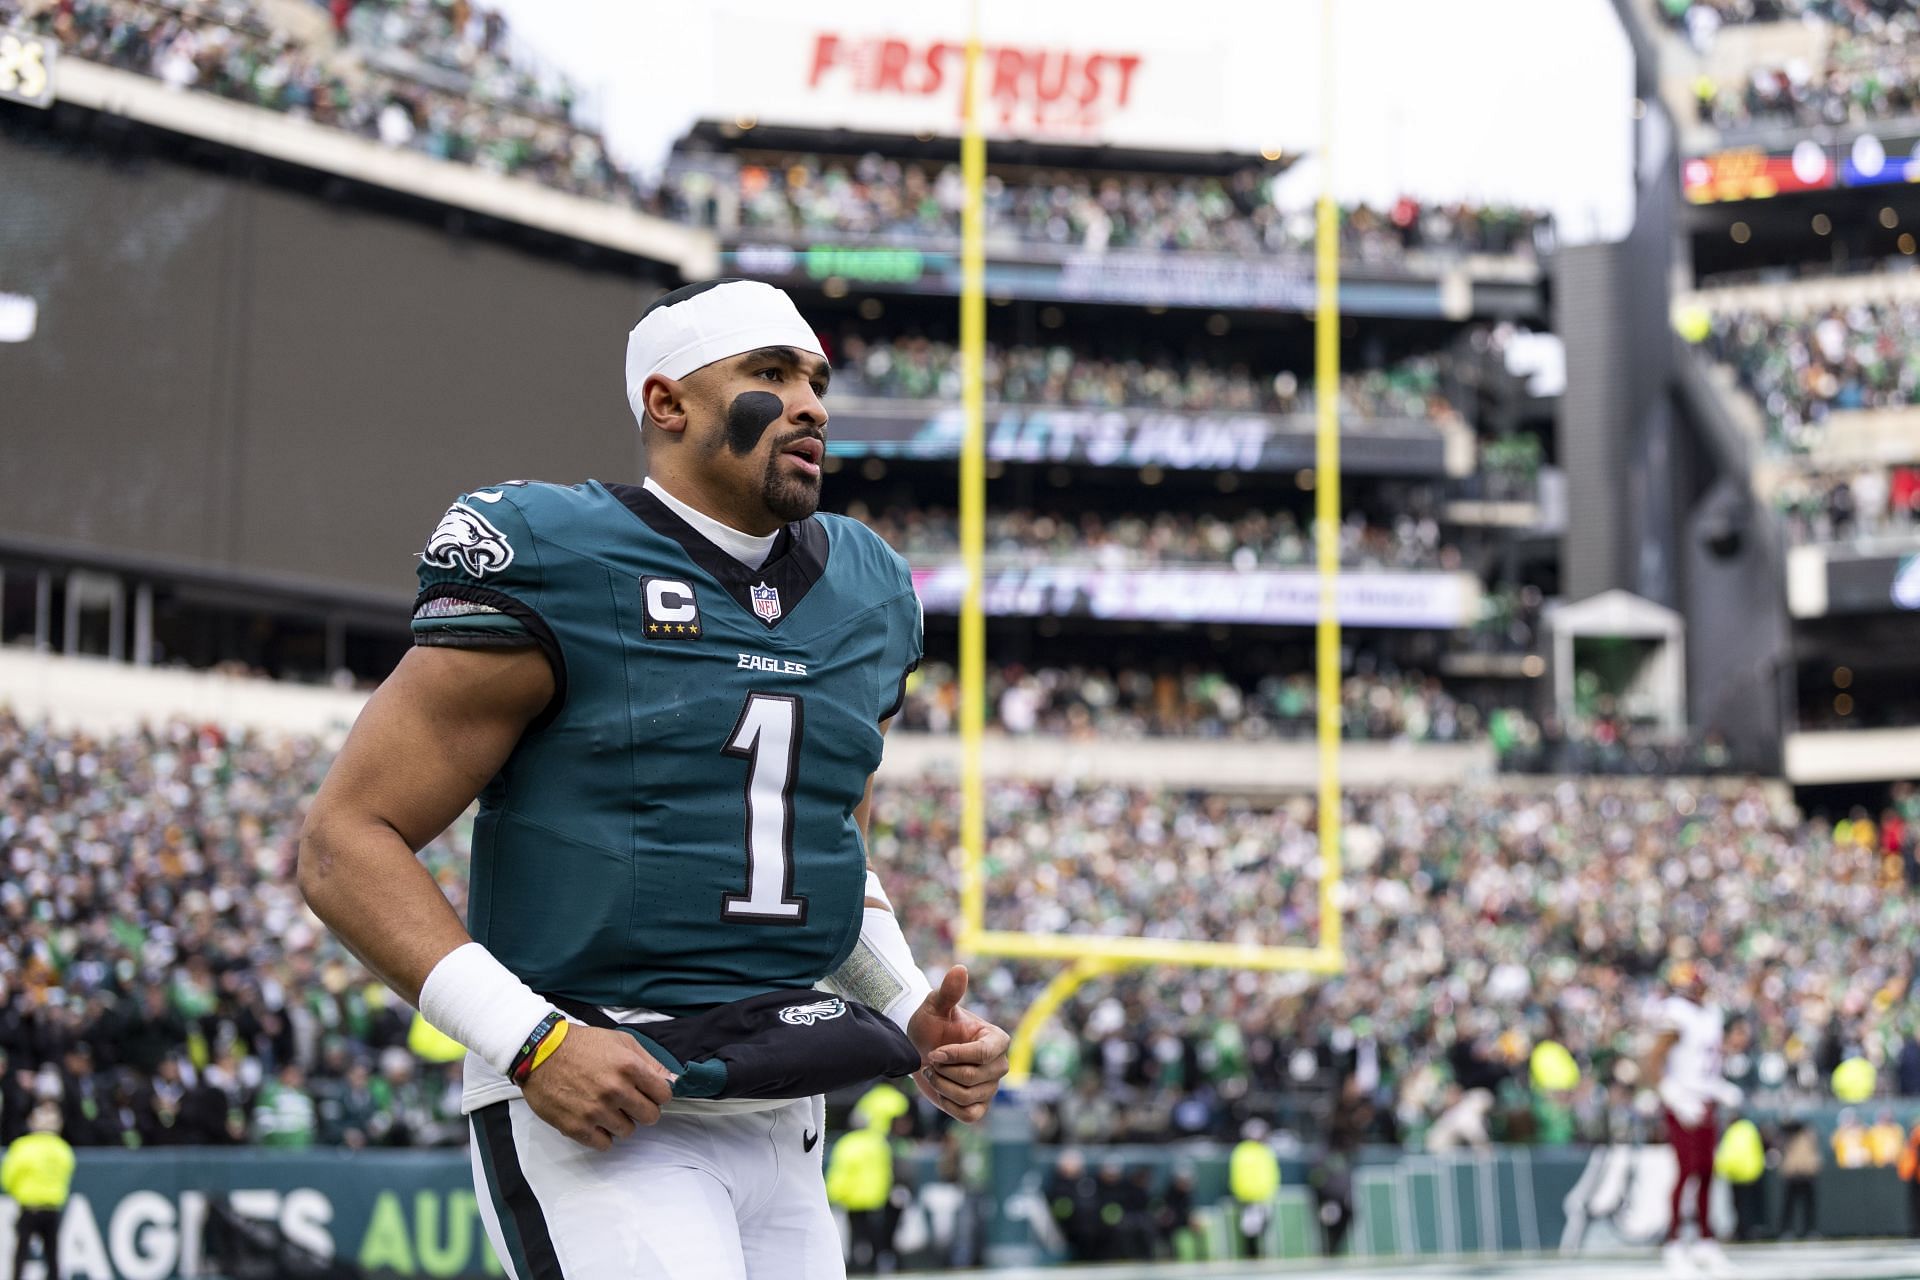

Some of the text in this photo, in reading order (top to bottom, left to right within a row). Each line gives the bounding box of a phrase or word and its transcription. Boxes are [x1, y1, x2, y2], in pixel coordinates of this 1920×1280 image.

[646, 579, 696, 622] C
[757, 600, 778, 615] NFL
[737, 653, 808, 676] EAGLES
[720, 689, 808, 927] 1
